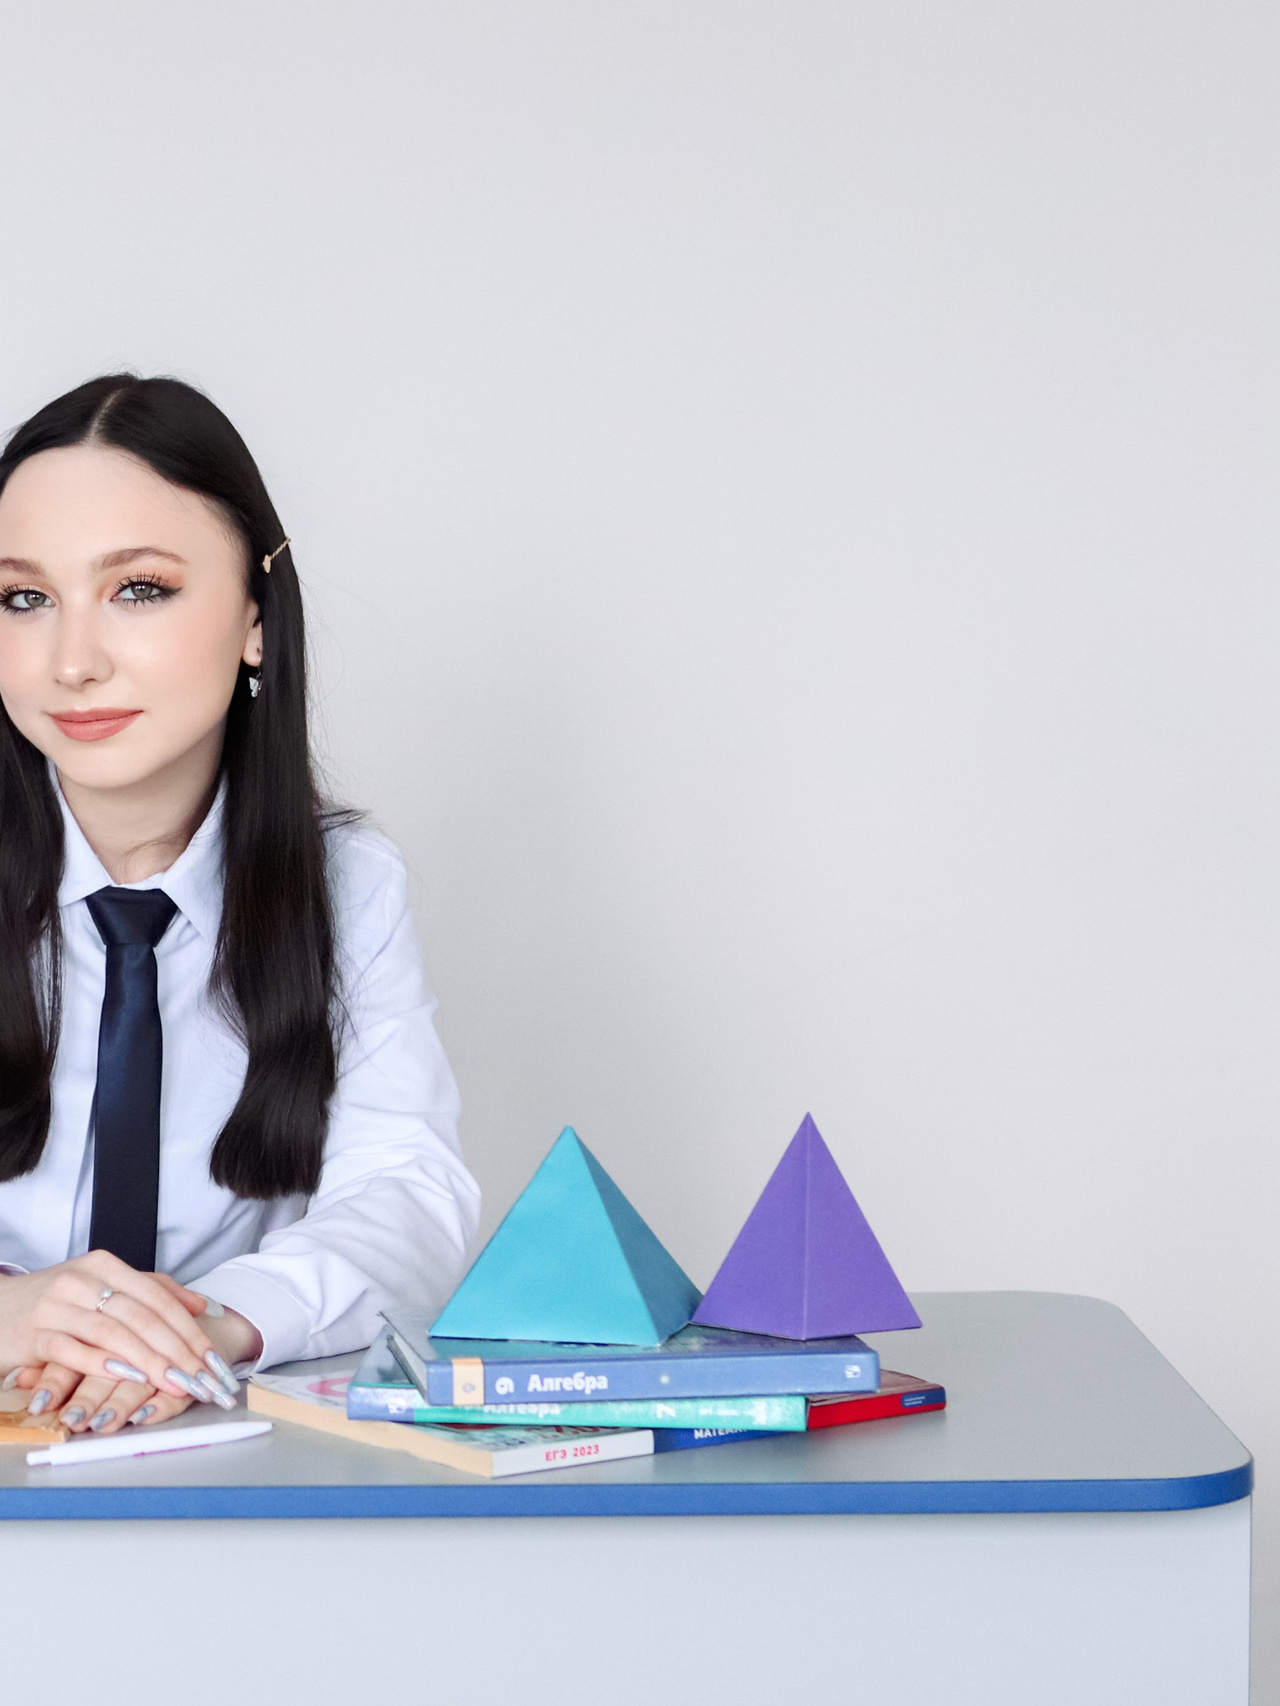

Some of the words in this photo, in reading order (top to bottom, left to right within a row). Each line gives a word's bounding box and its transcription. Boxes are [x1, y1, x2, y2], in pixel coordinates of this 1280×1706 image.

[527, 1371, 608, 1395] Алгебра
[545, 1449, 567, 1462] ЕГЭ
[573, 1444, 600, 1458] 2023
